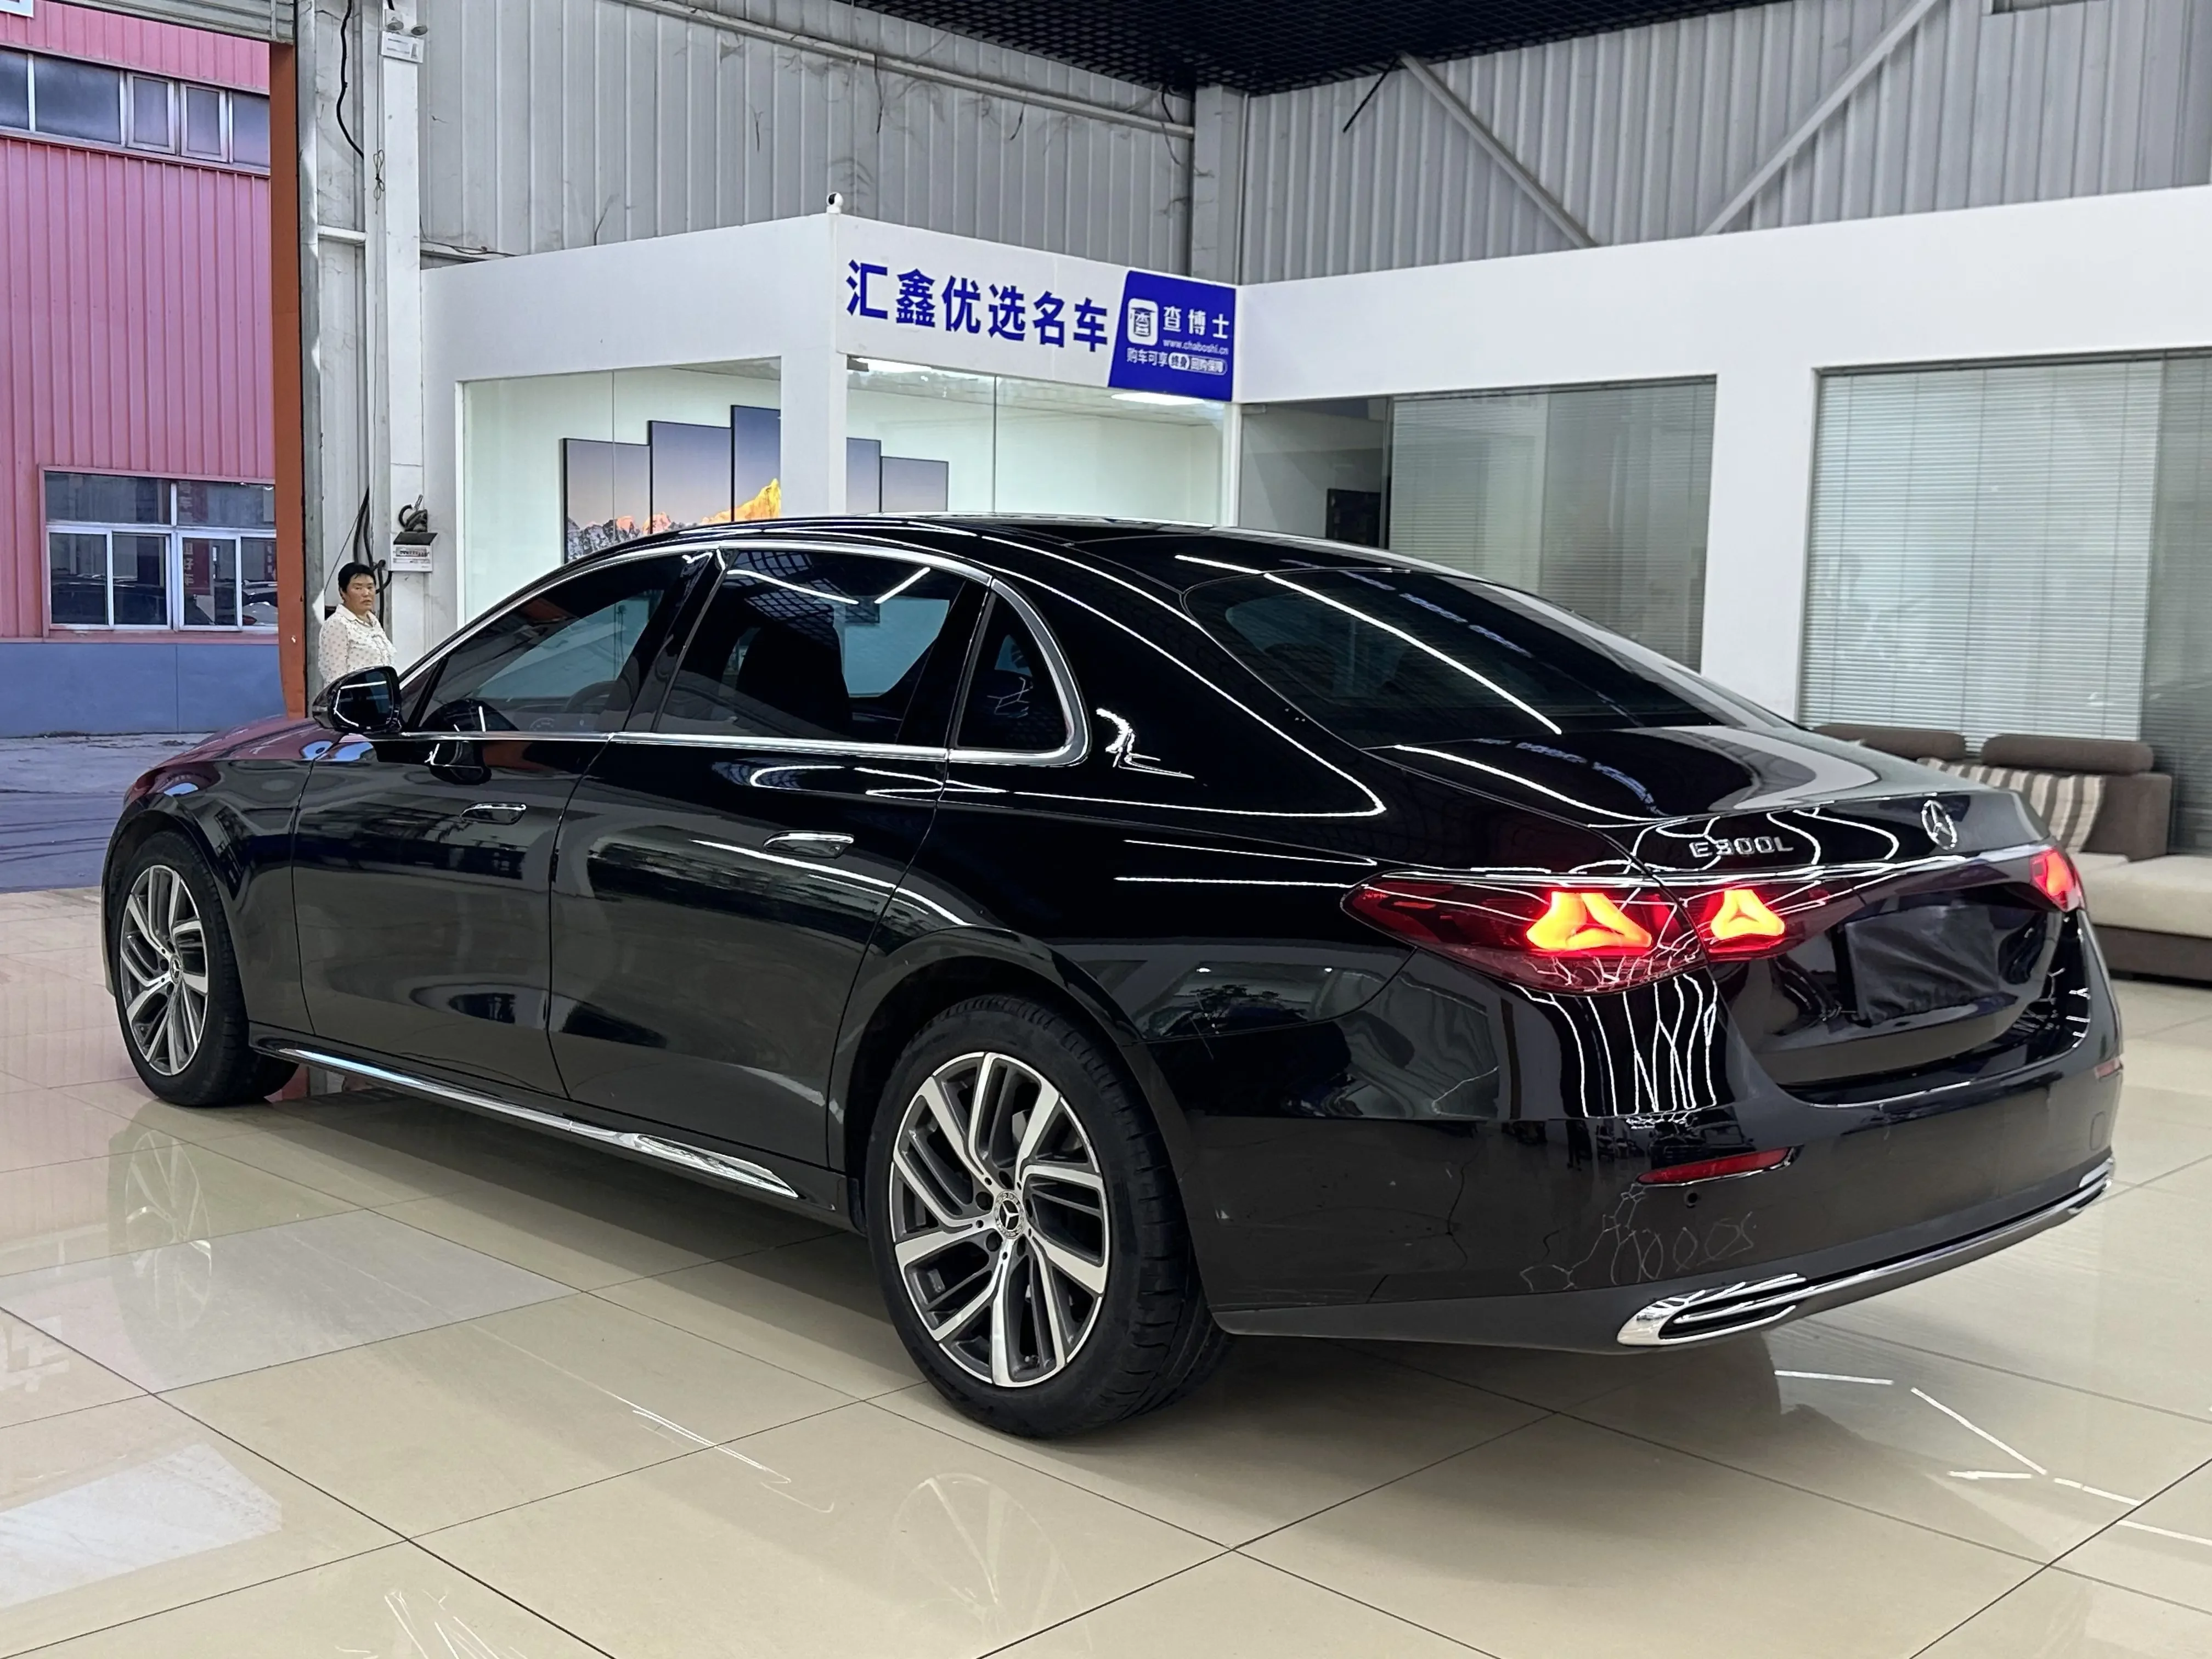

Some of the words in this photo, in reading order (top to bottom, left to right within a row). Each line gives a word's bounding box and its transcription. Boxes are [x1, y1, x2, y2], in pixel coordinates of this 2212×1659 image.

[846, 259, 1108, 352] 汇鑫优选名车
[1163, 306, 1229, 339] 查博士
